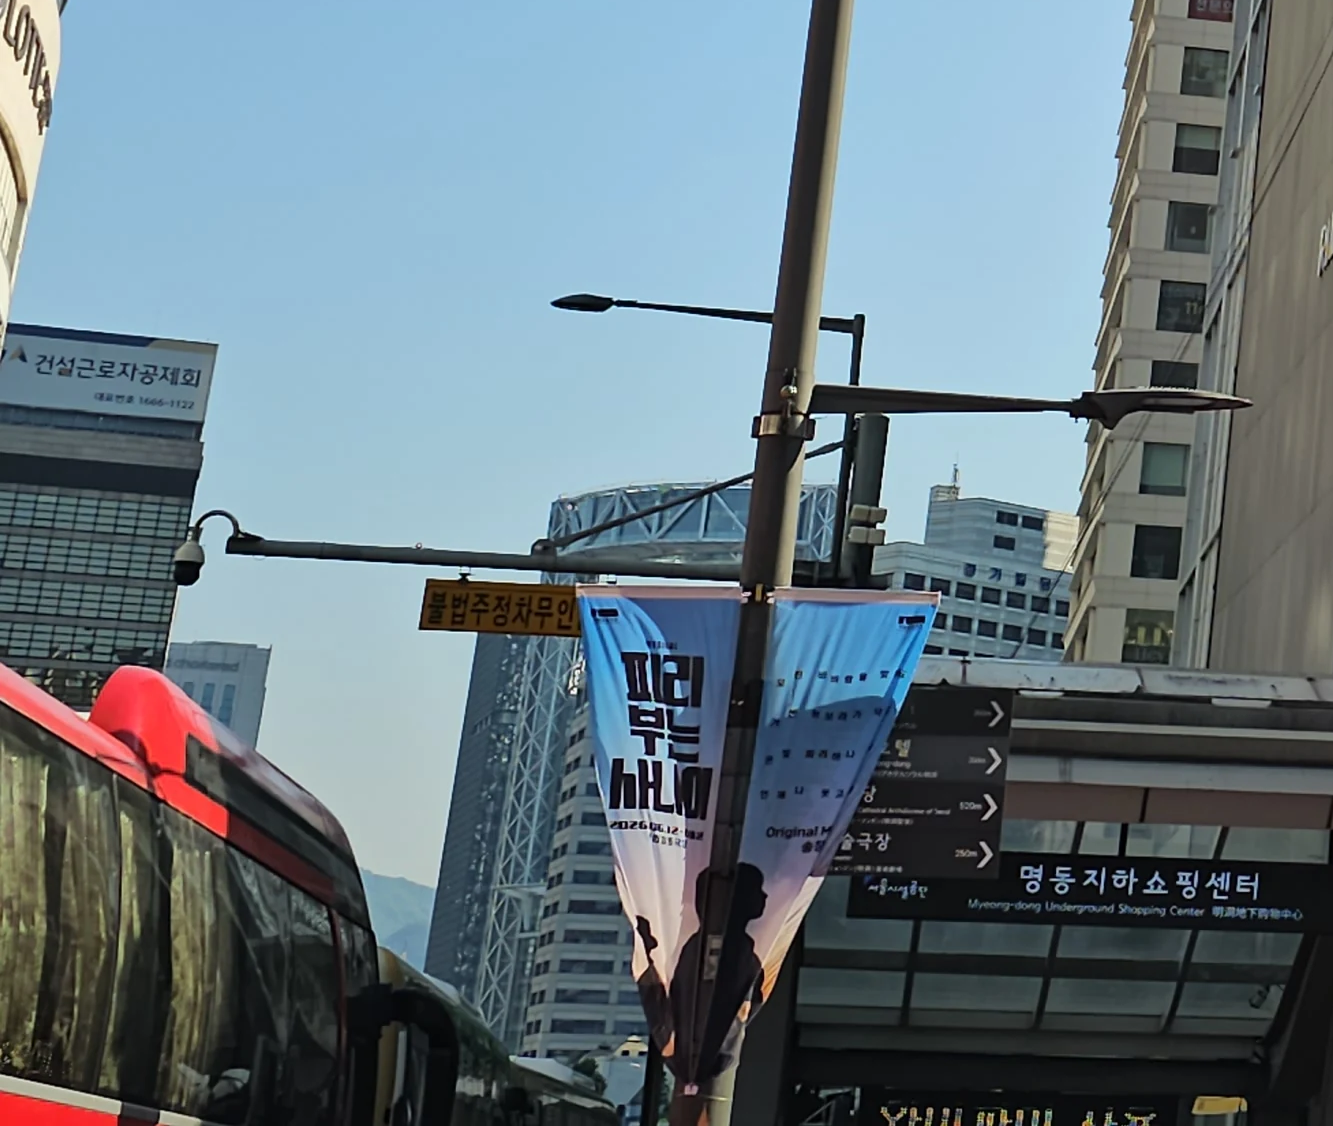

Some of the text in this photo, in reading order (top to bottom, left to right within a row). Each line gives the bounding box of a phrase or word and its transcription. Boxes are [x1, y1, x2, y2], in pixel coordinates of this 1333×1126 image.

[34, 354, 201, 388] 건설근로자공제회
[427, 591, 575, 630] 불법주정차무인
[621, 651, 704, 708] 피리
[628, 704, 700, 763] 부는
[766, 825, 819, 840] Original
[841, 832, 891, 851] 술극장
[1020, 864, 1259, 900] 명동지하쇼핑센터
[968, 898, 1041, 913] Myeong-dong
[1045, 900, 1115, 915] Underground
[1118, 903, 1166, 917] Shopping
[1169, 905, 1204, 917] Center
